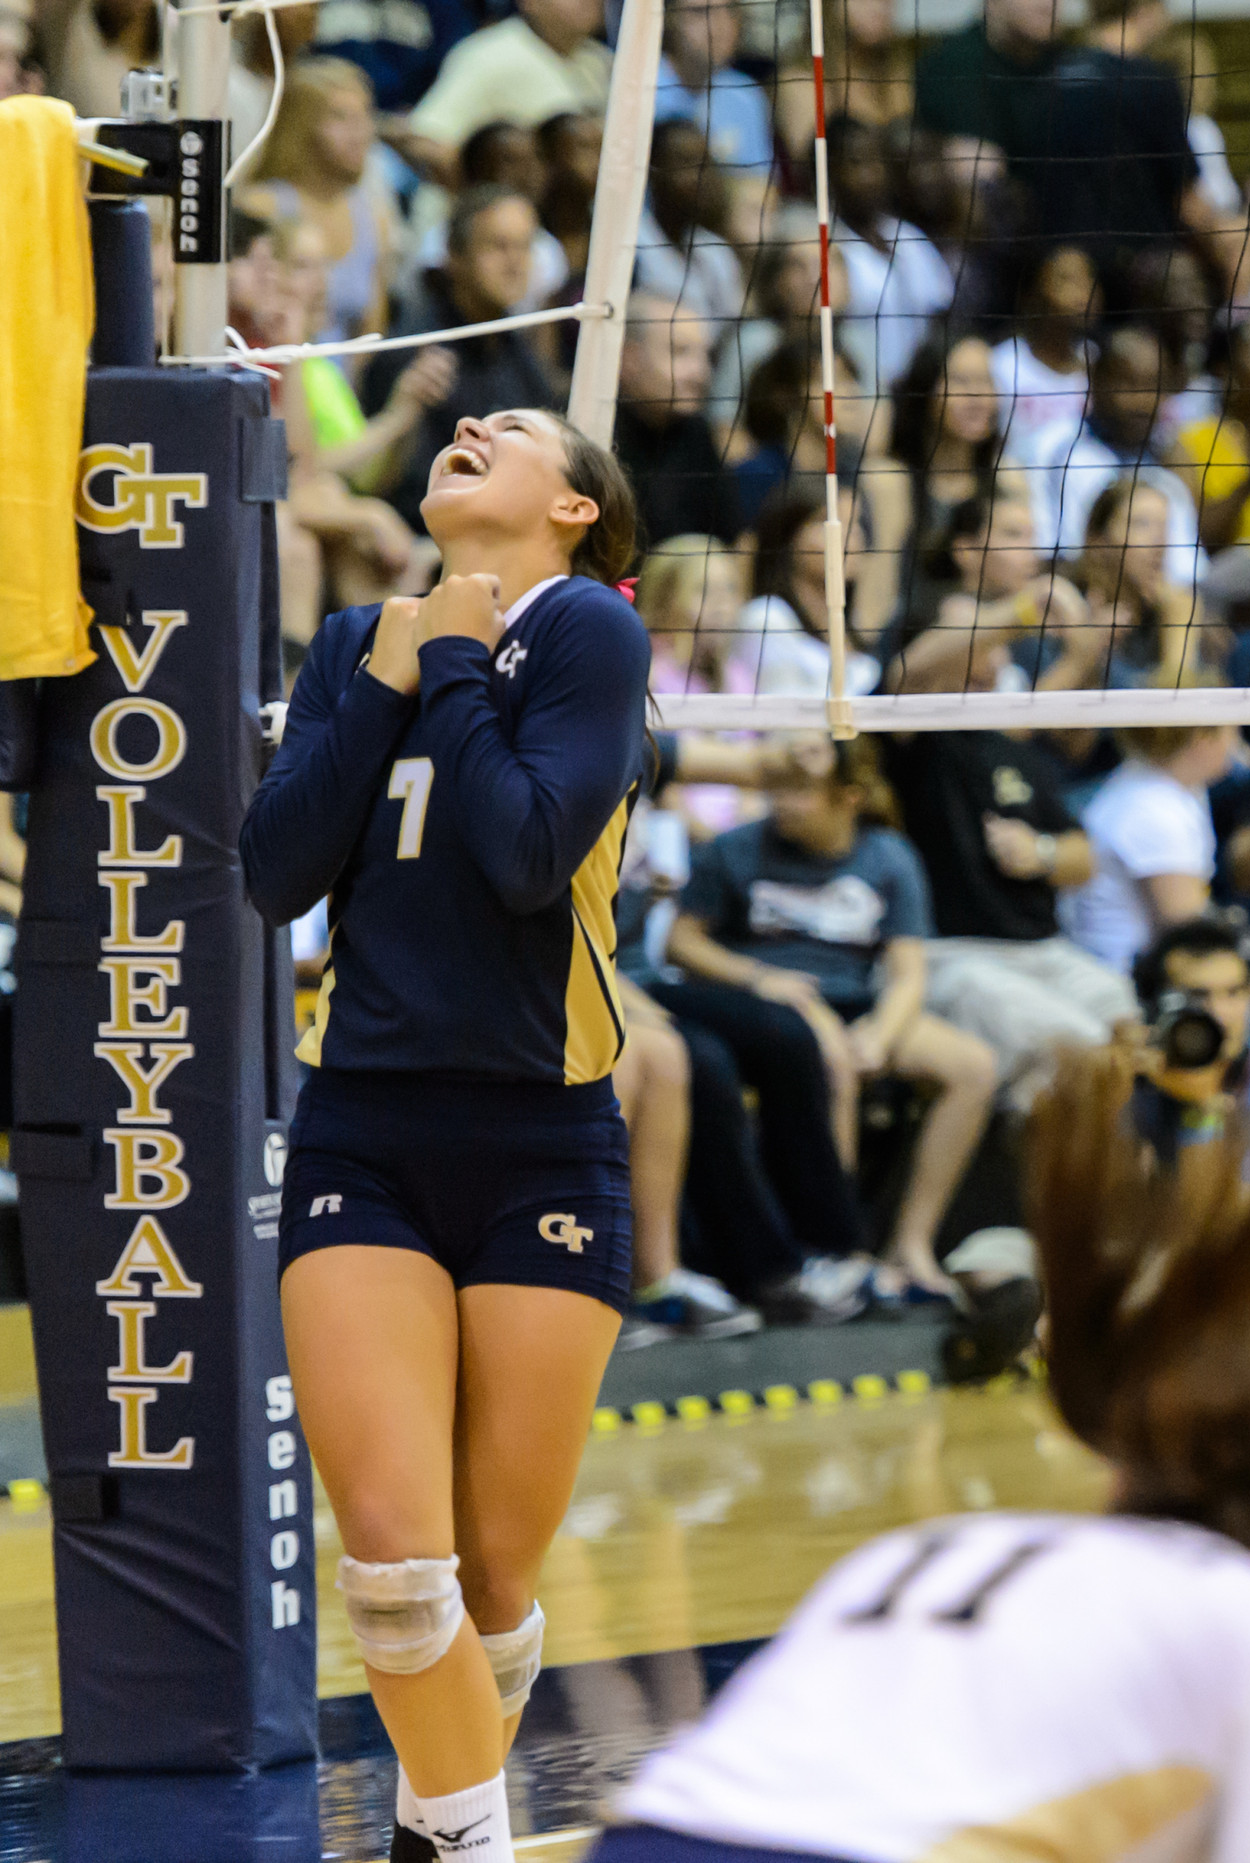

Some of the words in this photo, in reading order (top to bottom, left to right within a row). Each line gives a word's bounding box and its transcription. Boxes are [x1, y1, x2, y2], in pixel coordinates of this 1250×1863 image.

[73, 442, 208, 549] GT
[387, 756, 435, 860] 7
[90, 609, 204, 1470] VOLLEYBALL
[537, 1213, 594, 1254] GT
